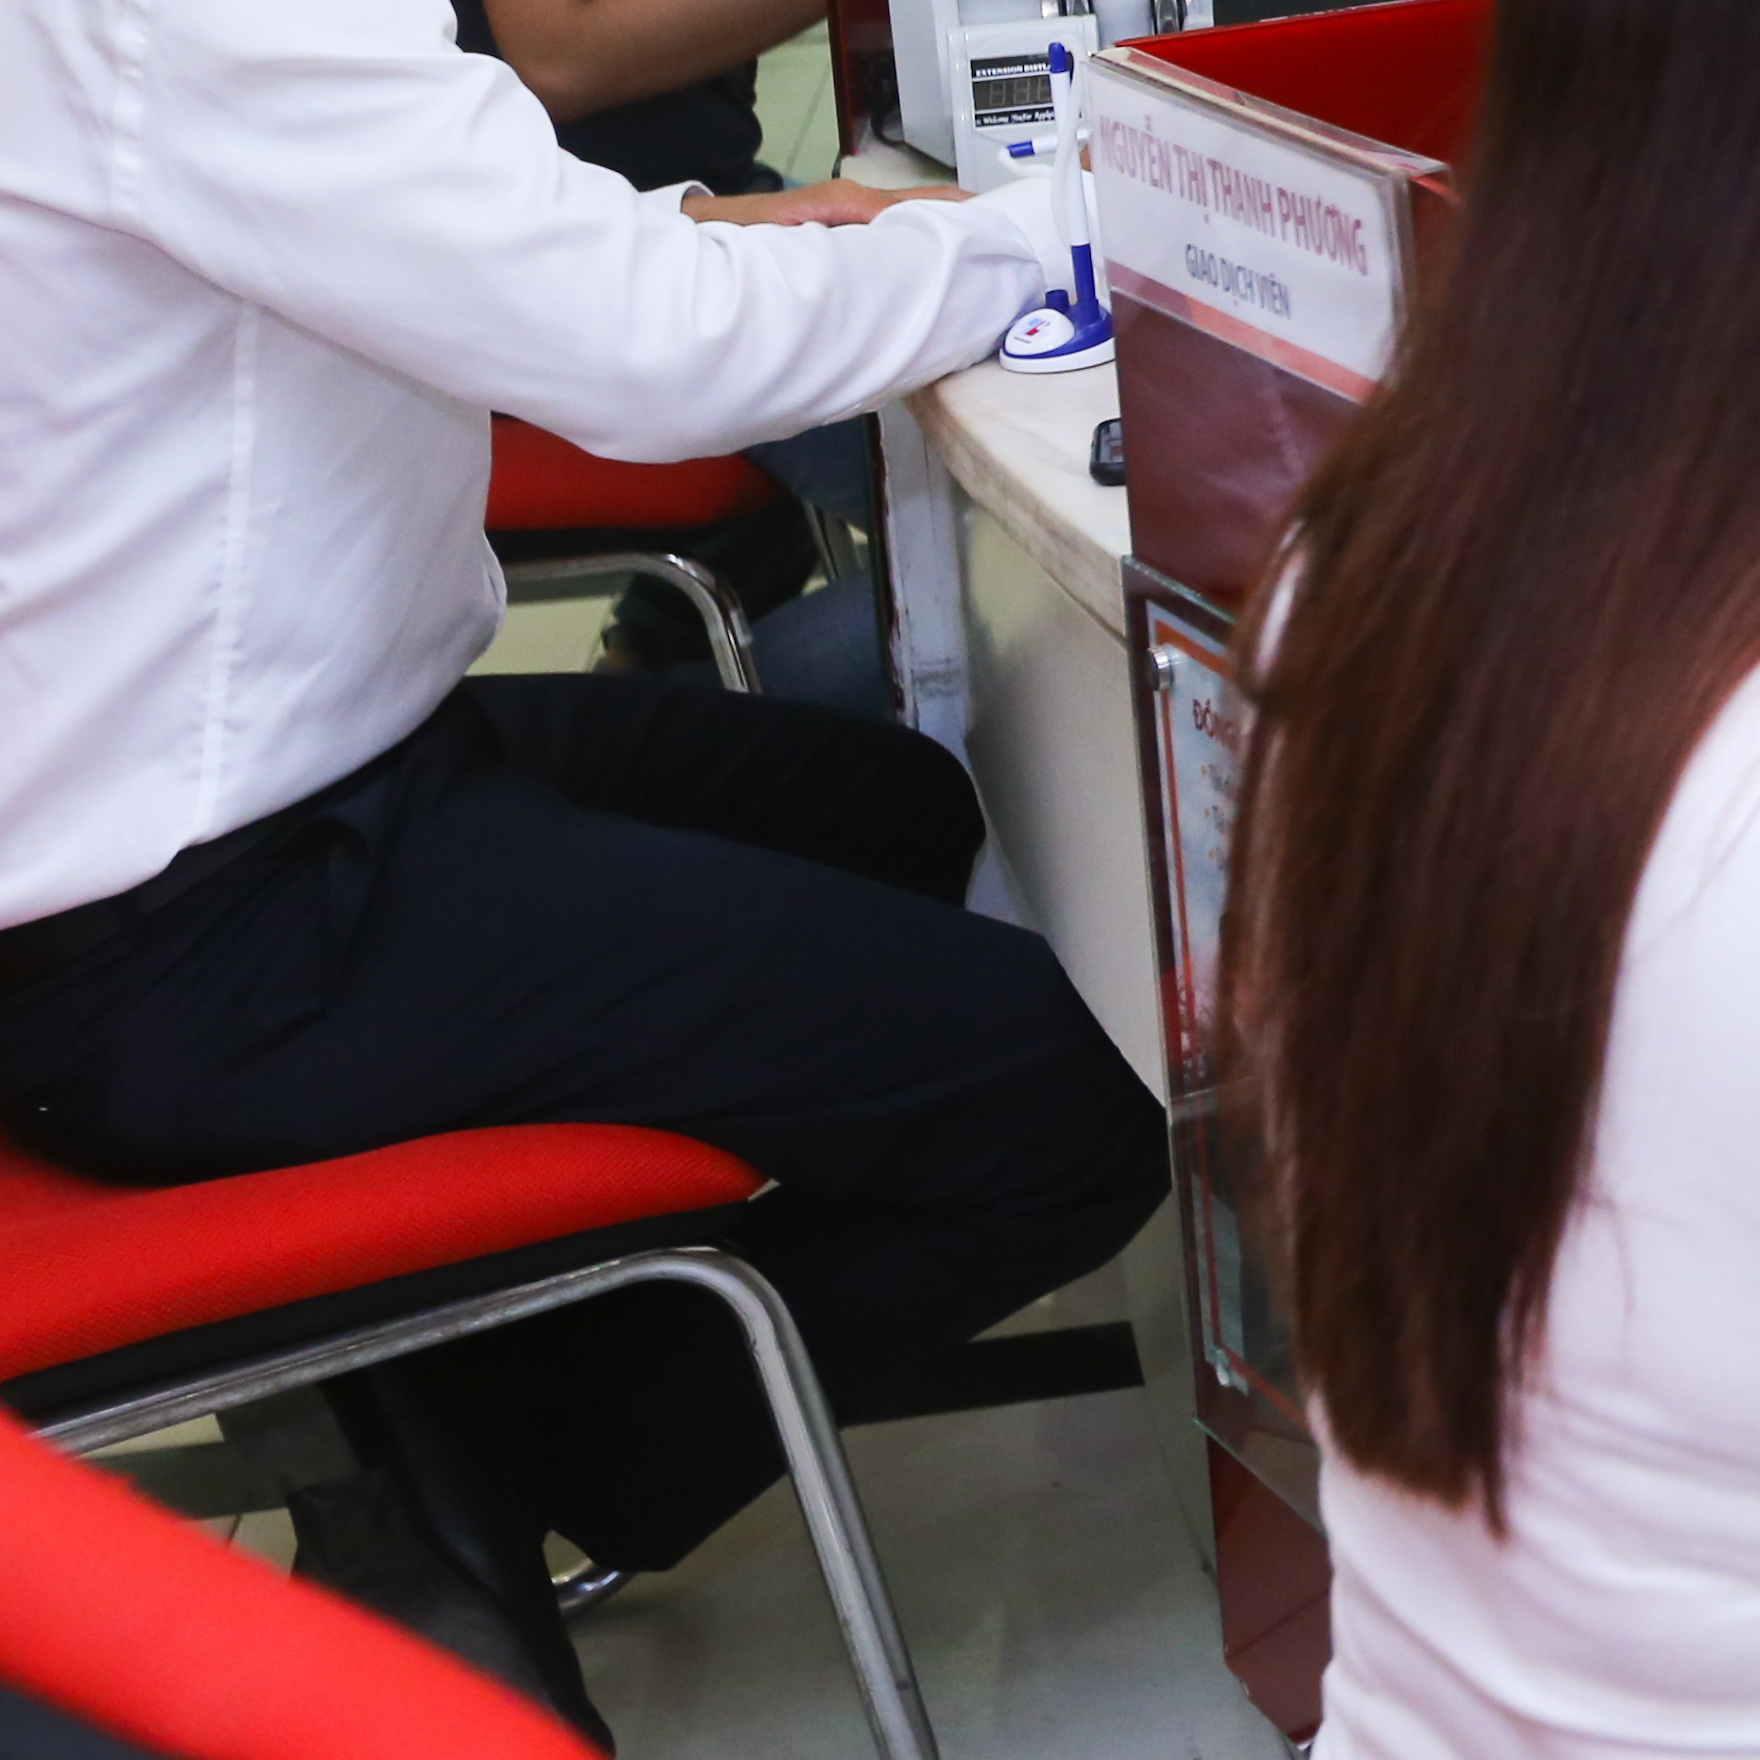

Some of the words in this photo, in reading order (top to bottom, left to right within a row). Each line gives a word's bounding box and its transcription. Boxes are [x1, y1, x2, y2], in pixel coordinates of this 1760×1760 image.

[1173, 144, 1208, 225] THỊ
[1207, 158, 1275, 238] THANH
[1185, 243, 1218, 287] GIAO
